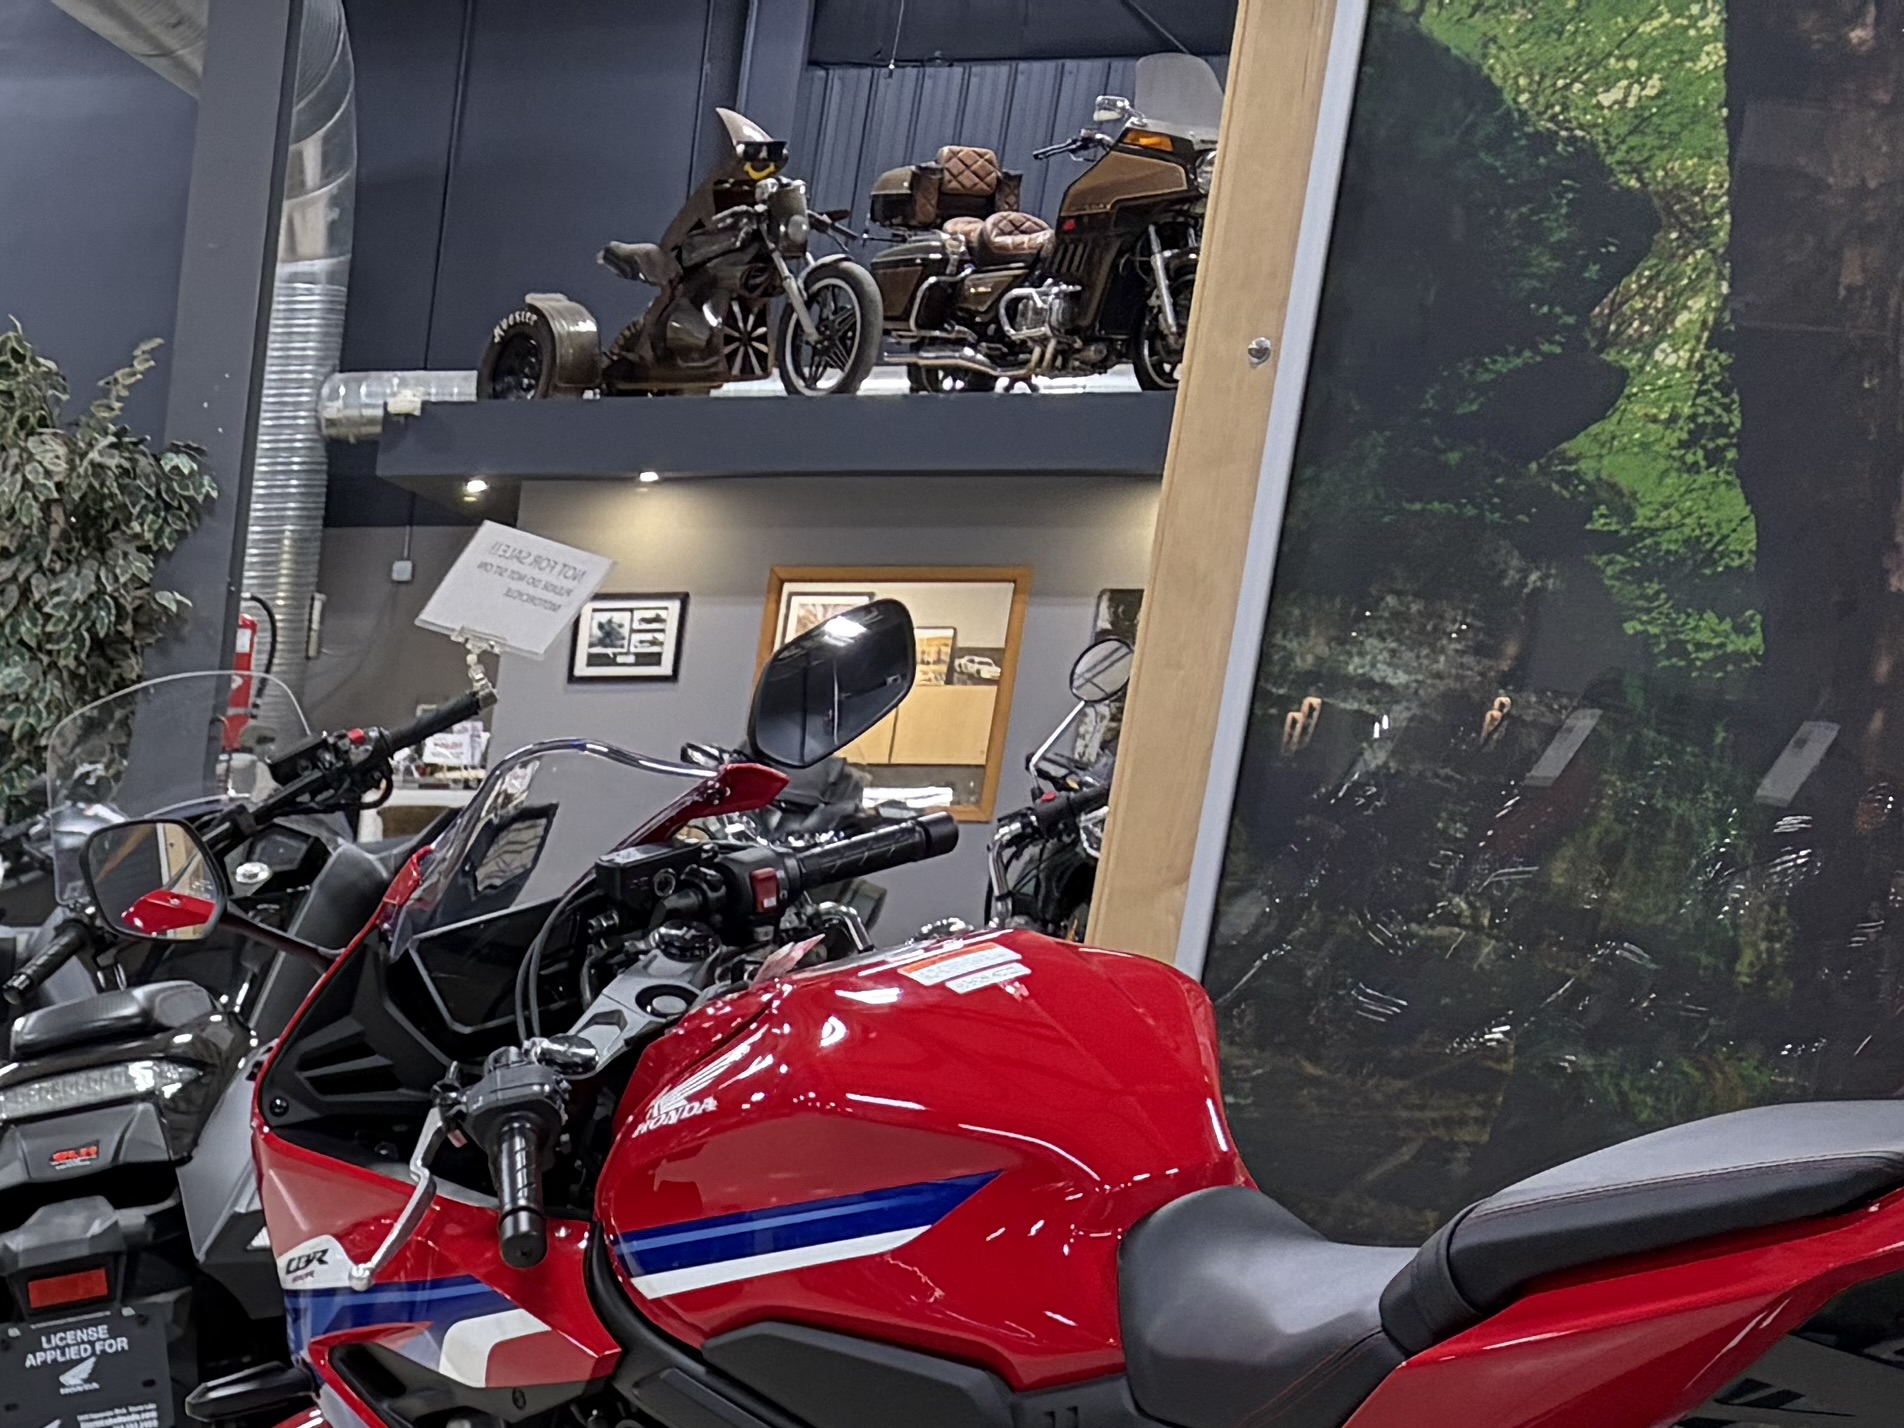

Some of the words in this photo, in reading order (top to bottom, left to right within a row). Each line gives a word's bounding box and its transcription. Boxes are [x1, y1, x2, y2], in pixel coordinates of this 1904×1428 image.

[632, 1095, 718, 1138] HONDA
[25, 1345, 92, 1368] APPLIED
[95, 1337, 129, 1355] FOR
[41, 1325, 109, 1349] LICENSE
